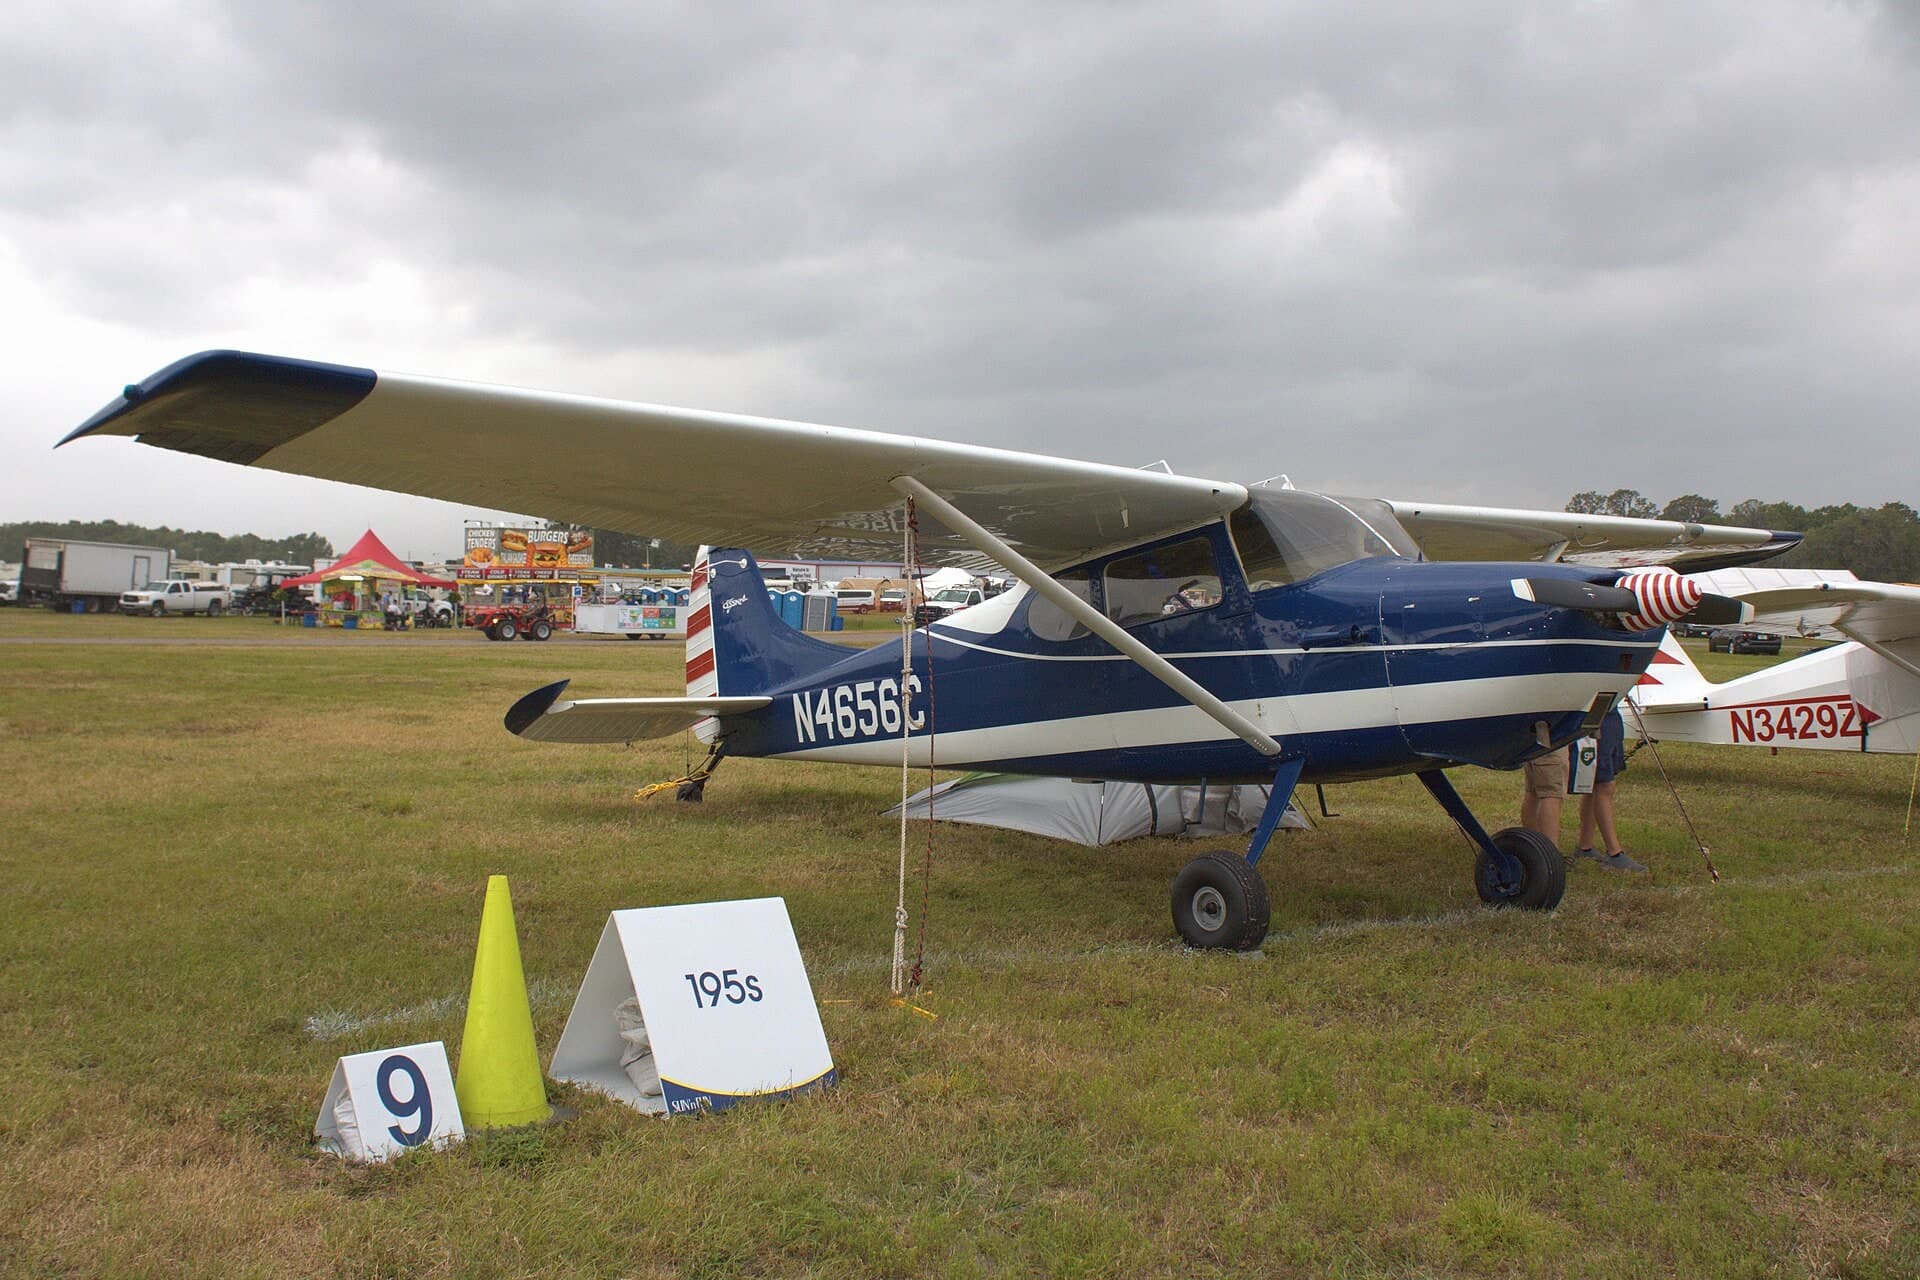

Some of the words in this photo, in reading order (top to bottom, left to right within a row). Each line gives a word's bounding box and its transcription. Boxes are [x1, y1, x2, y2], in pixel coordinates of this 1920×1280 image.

[467, 538, 496, 549] TENDERS
[468, 530, 495, 538] CHICKEN
[528, 531, 569, 544] BURGERS
[792, 674, 926, 744] N4656C
[1730, 702, 1865, 743] N3429Z
[685, 969, 763, 1008] 195s
[376, 1054, 433, 1147] 9
